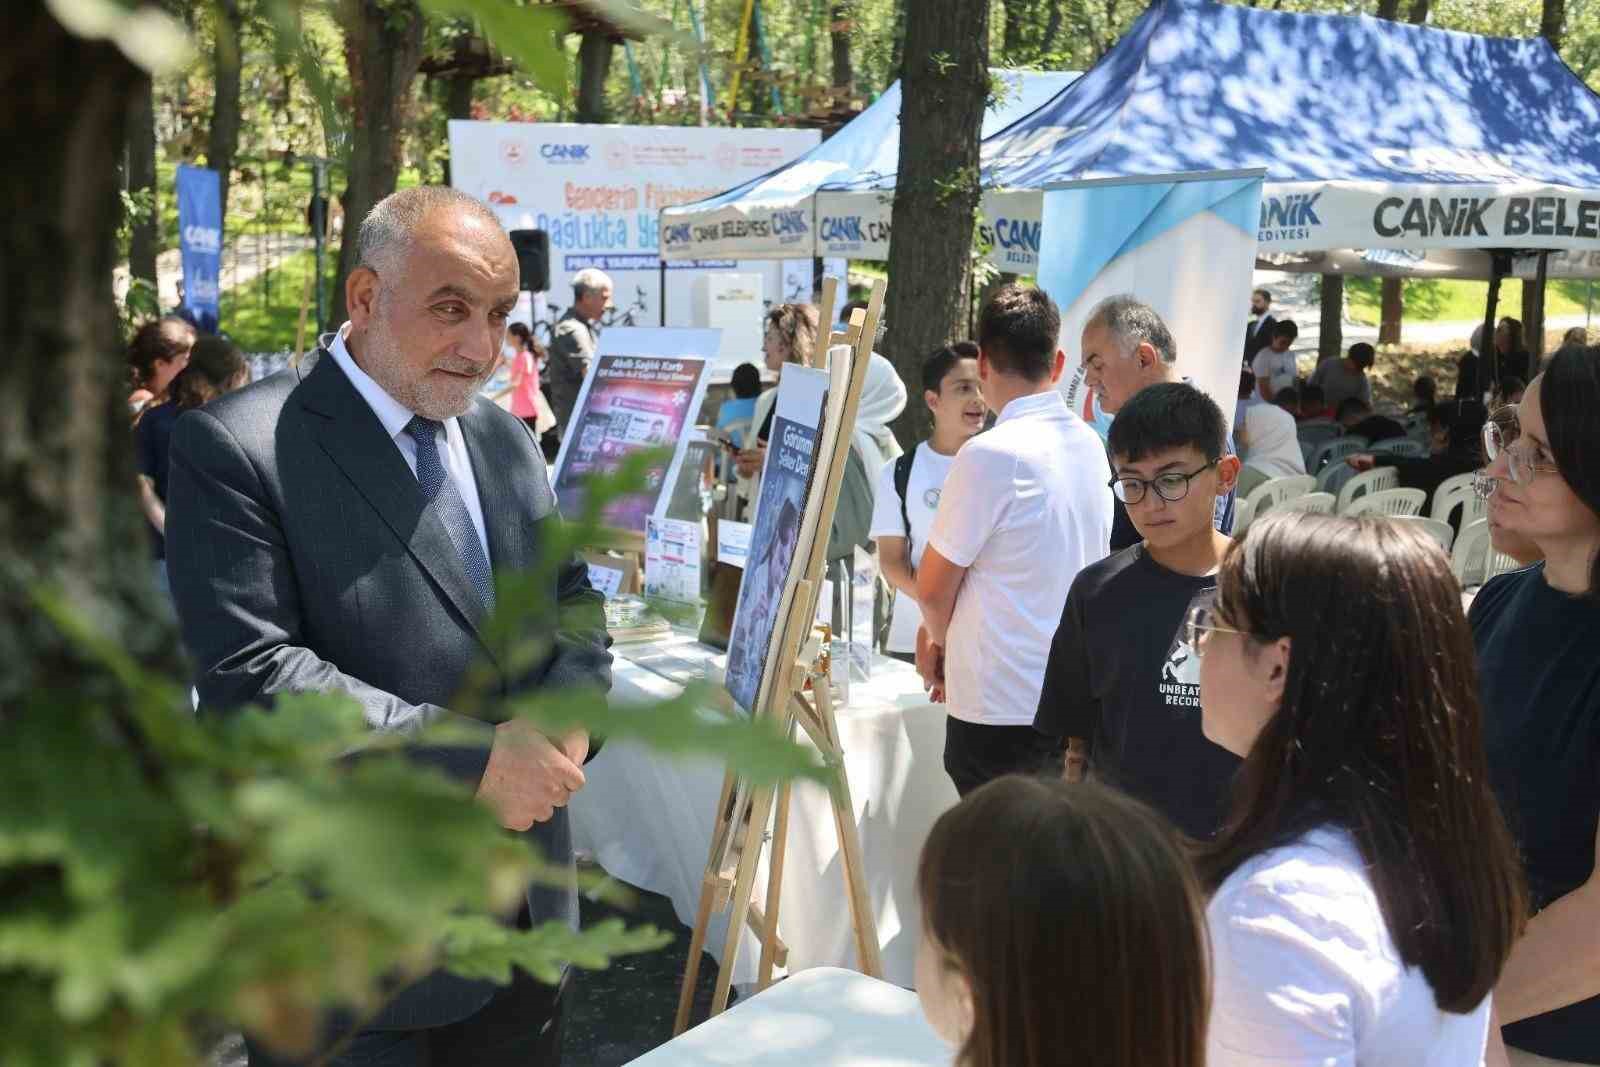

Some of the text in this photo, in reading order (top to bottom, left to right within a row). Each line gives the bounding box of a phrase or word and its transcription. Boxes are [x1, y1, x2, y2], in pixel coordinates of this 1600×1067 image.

[1503, 196, 1600, 239] BELE
[1159, 683, 1200, 696] UNBEAT
[1165, 694, 1201, 707] RECOR
